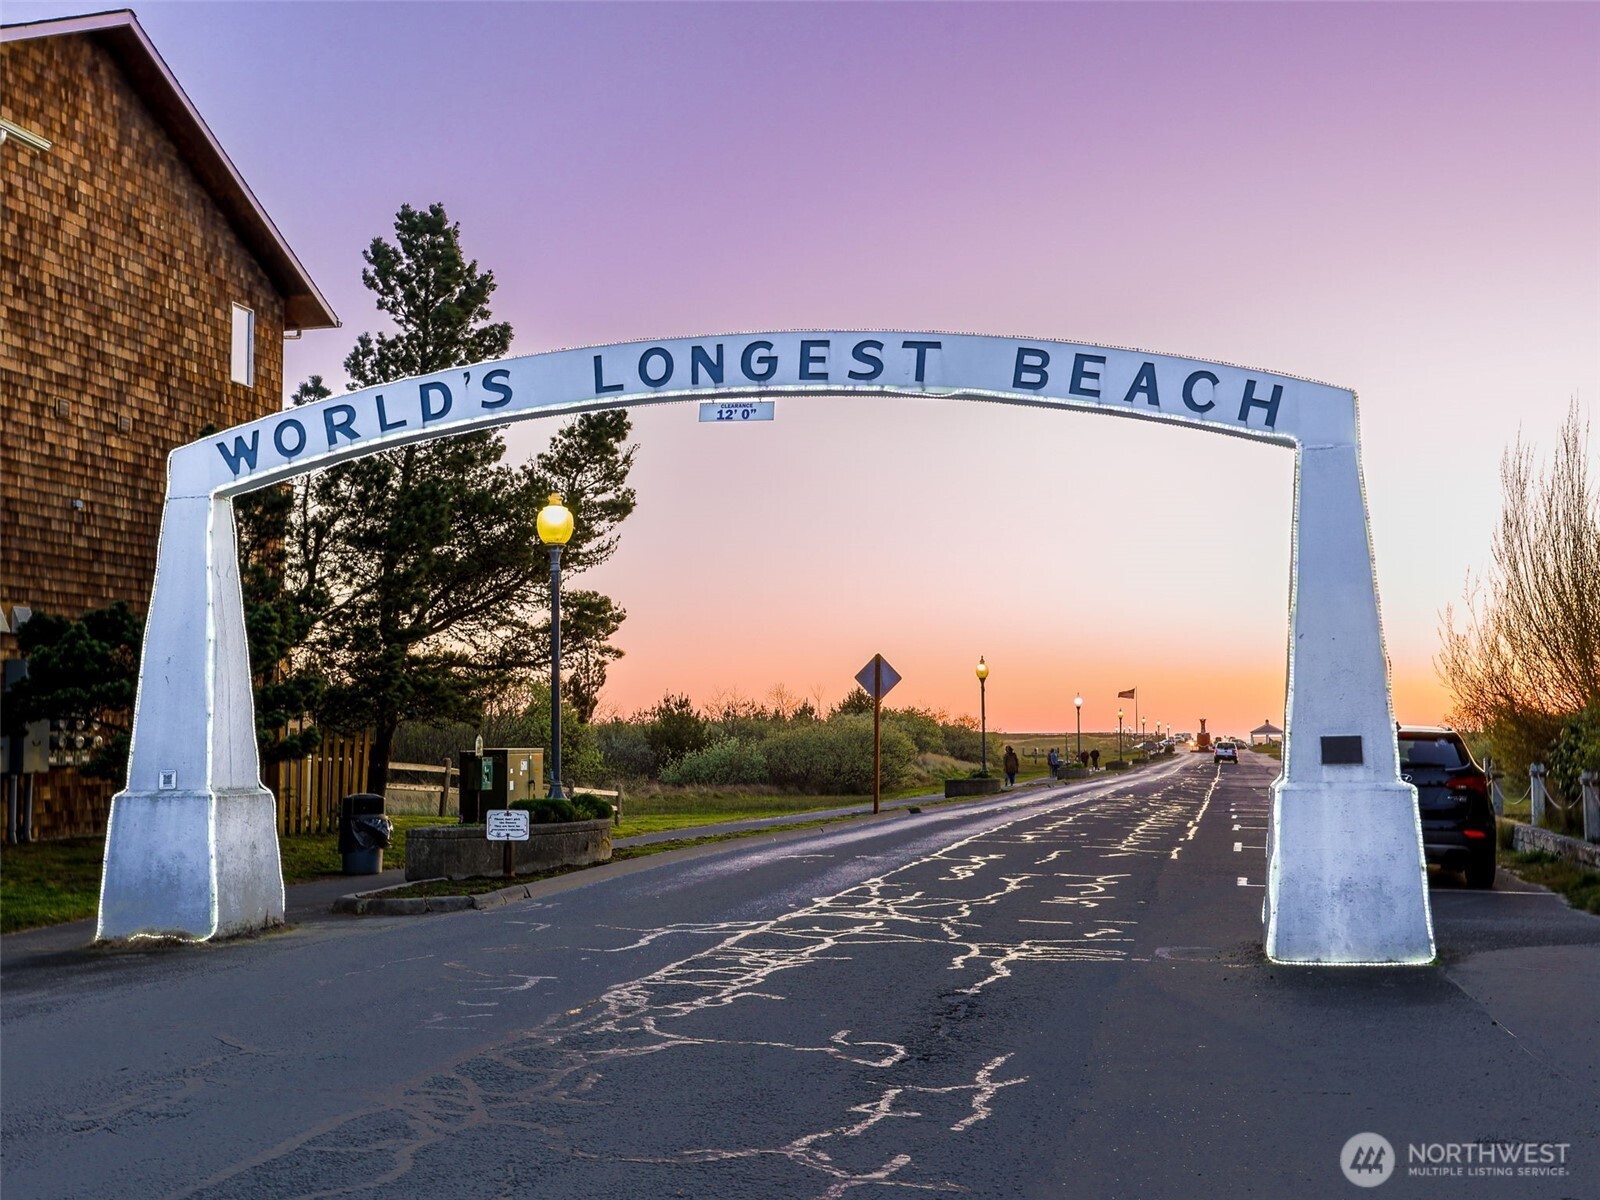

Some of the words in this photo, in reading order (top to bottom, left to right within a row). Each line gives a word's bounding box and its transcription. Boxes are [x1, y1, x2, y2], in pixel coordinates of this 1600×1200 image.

[215, 368, 513, 477] WORLD'S
[593, 340, 942, 394] LONGEST
[1012, 346, 1284, 427] BEACH
[716, 409, 738, 420] 12'
[741, 408, 757, 420] 0"
